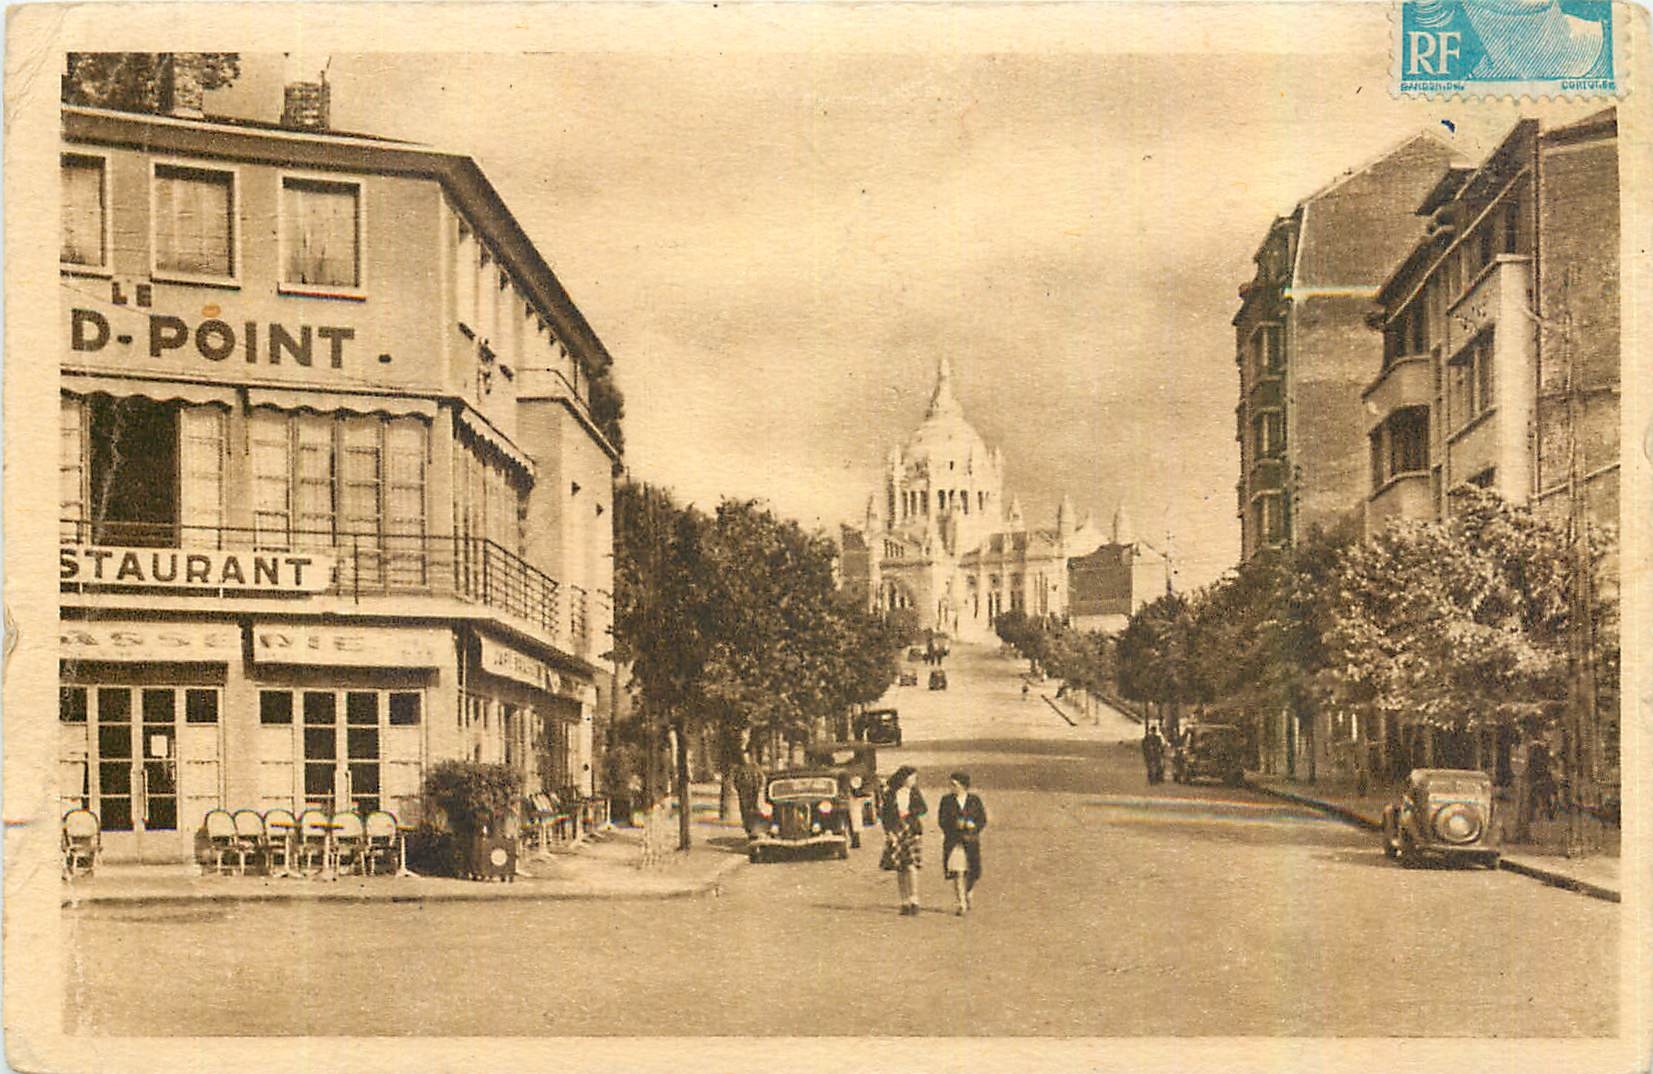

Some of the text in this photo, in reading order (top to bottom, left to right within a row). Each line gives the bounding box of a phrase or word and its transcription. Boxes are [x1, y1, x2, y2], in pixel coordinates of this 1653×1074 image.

[1405, 30, 1462, 76] RF
[111, 281, 152, 308] LE
[60, 548, 312, 586] STAURANT
